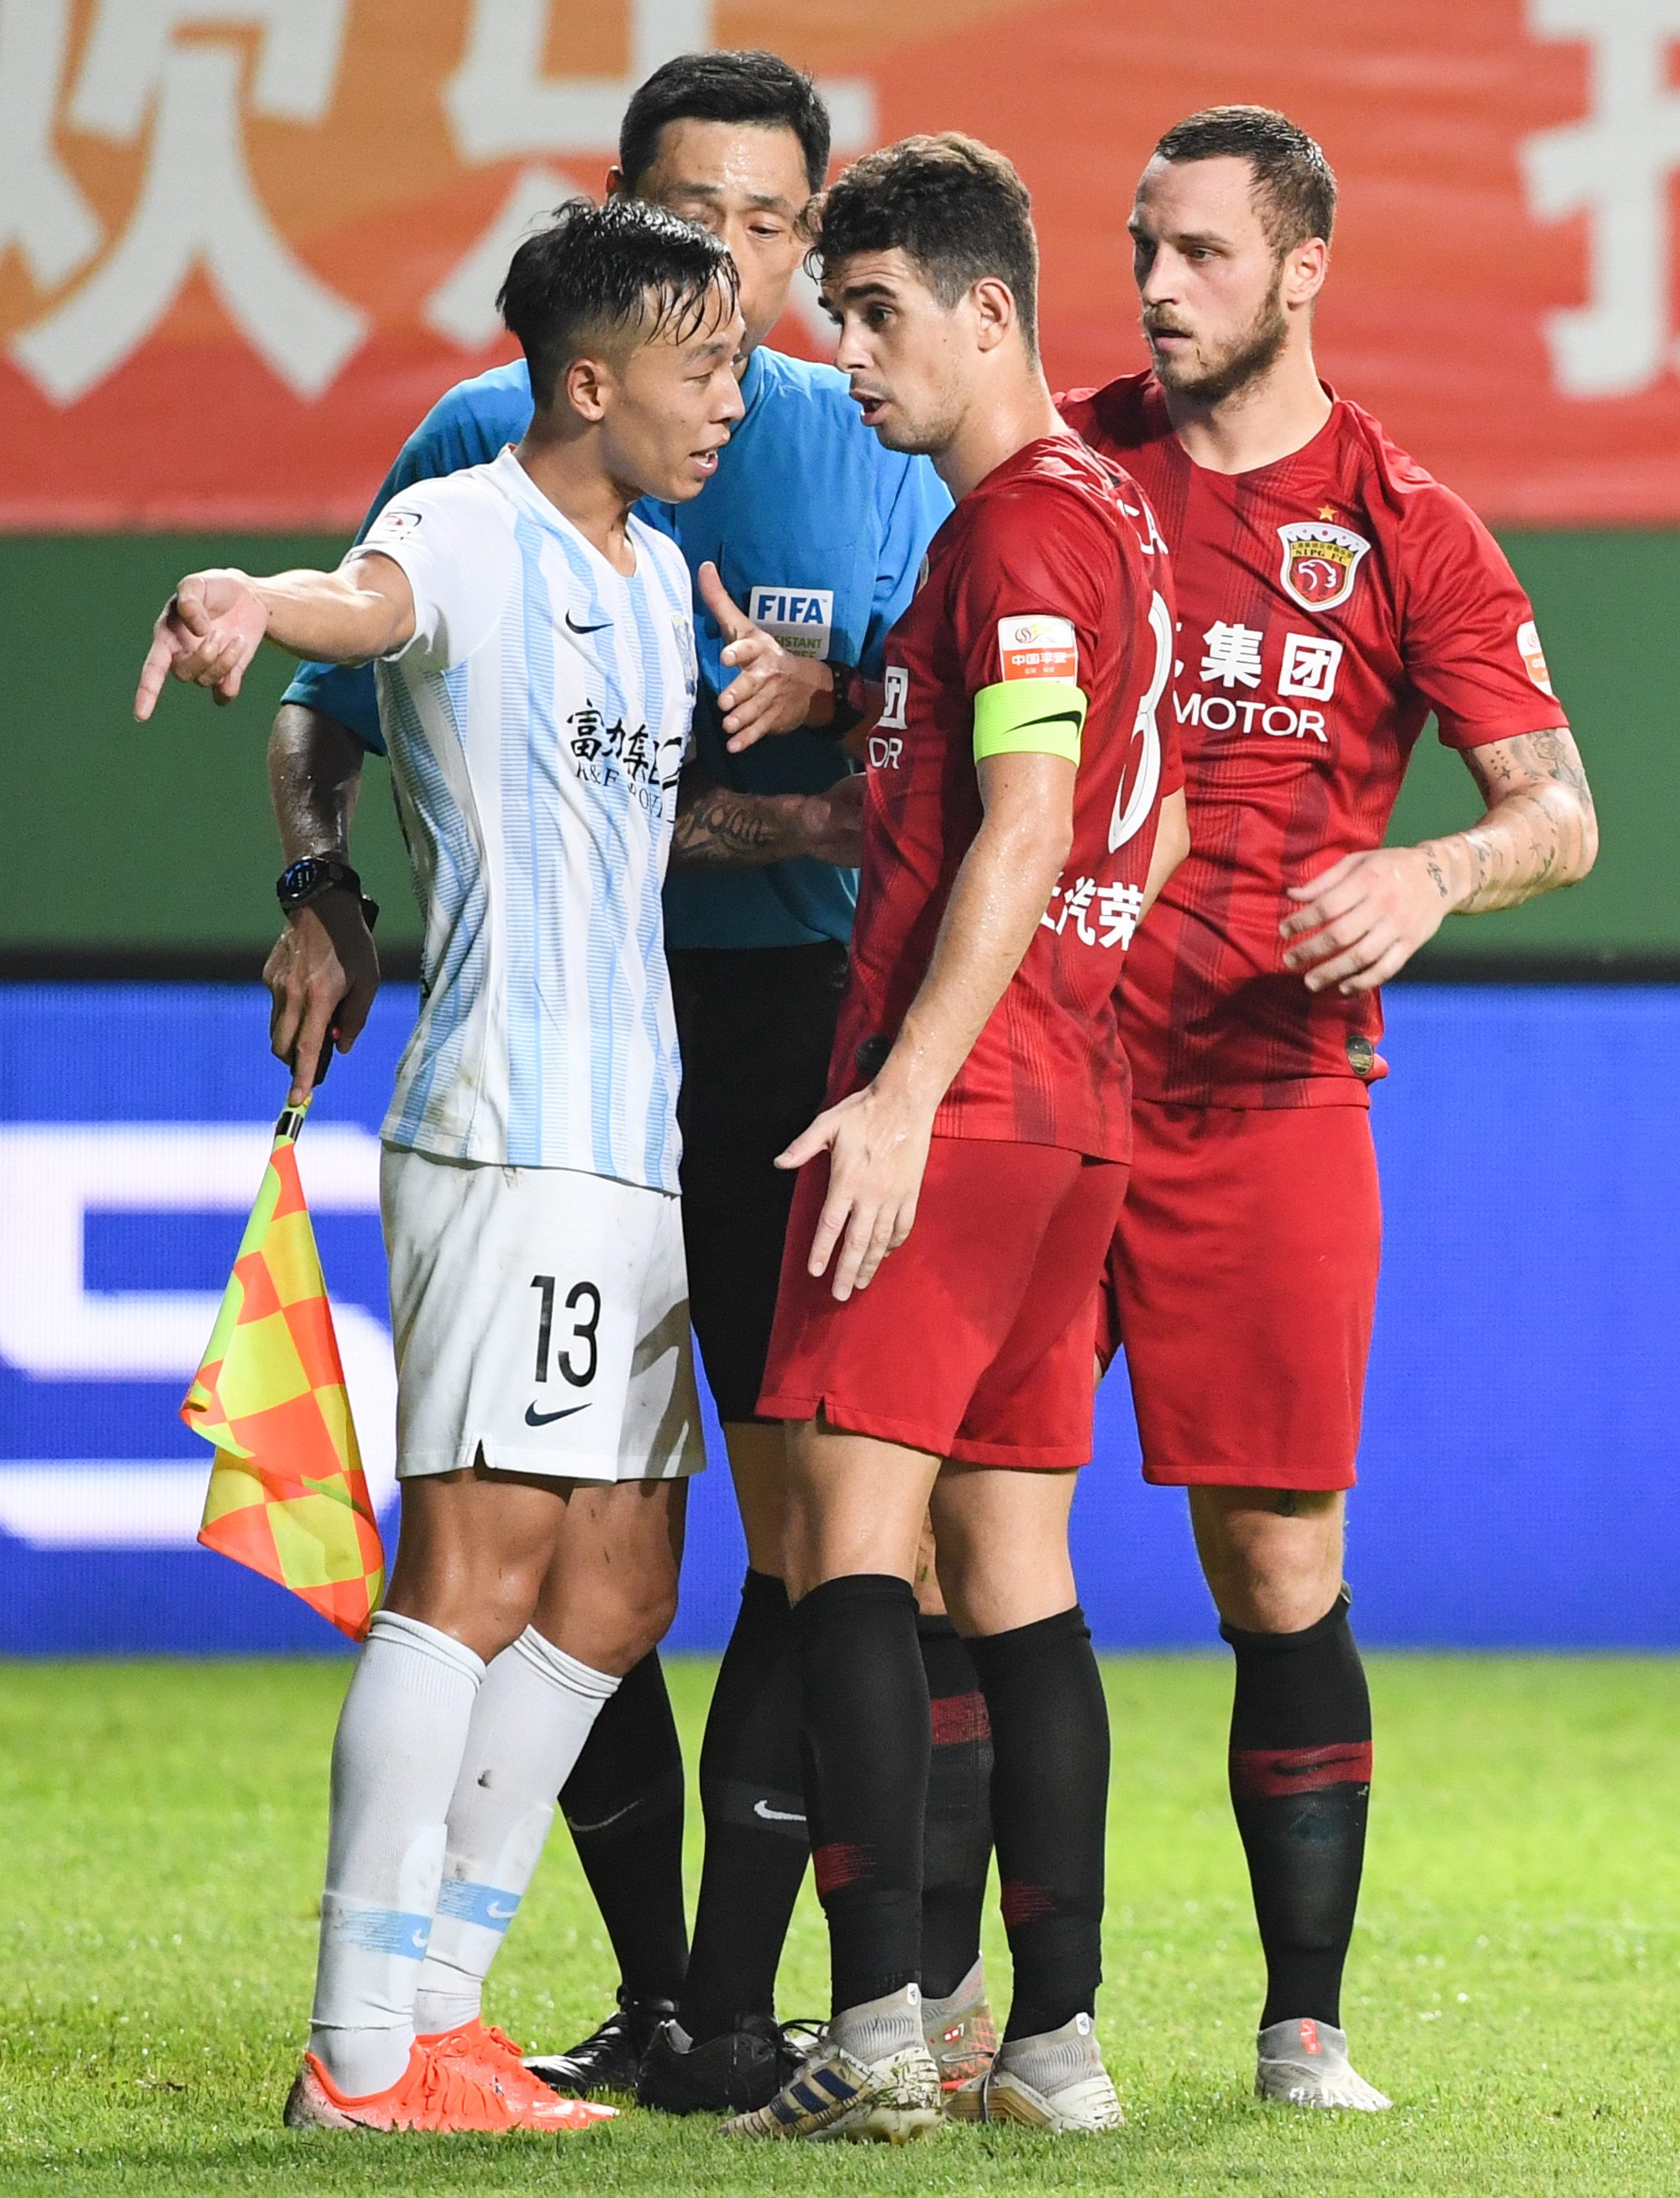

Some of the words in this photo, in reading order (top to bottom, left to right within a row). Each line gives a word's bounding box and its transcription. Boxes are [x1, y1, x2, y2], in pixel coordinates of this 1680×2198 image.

[1295, 548, 1325, 557] SIPG
[1331, 553, 1347, 563] FC
[758, 595, 823, 624] FIFA
[774, 636, 822, 648] ISTANT
[1174, 620, 1344, 702] 集团
[1173, 690, 1329, 742] MOTOR
[530, 1275, 601, 1388] 13
